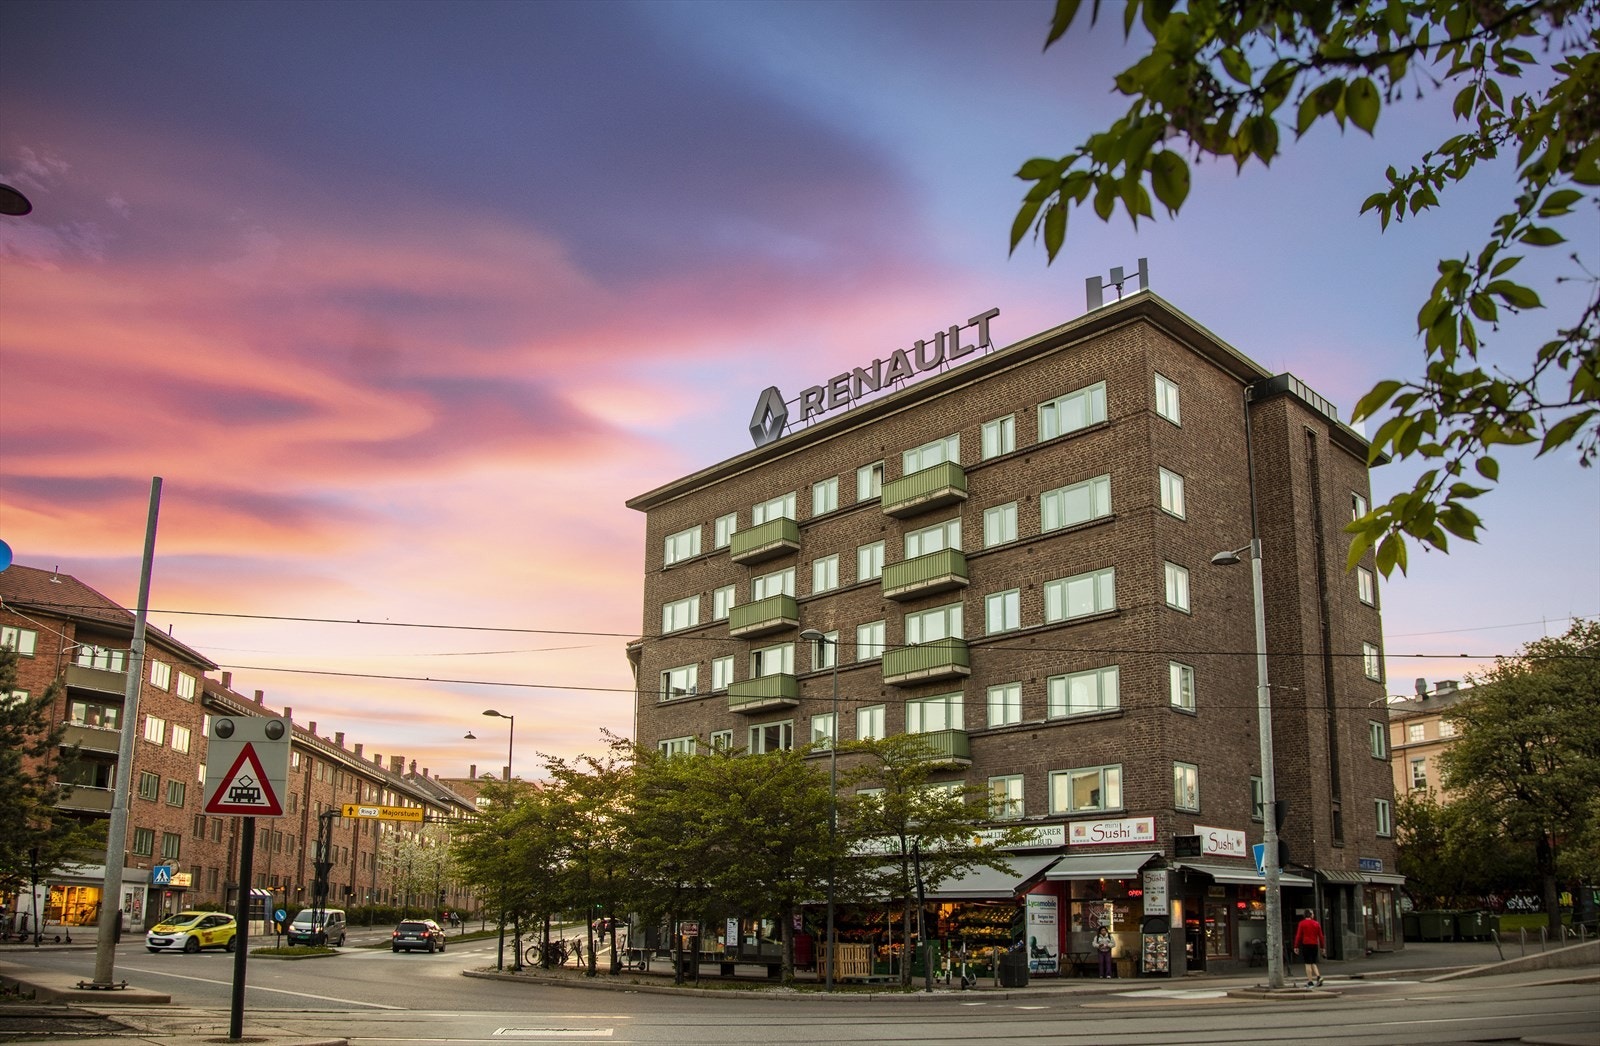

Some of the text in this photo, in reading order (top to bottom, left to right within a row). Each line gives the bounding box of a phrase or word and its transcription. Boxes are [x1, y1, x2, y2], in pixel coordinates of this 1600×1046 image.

[800, 307, 1000, 422] RENAULT
[382, 809, 419, 817] Majorstuen
[1091, 822, 1130, 842] Sushi
[1208, 831, 1234, 852] Sushi
[1128, 889, 1143, 897] OPEN
[1028, 899, 1056, 907] Lycamobile
